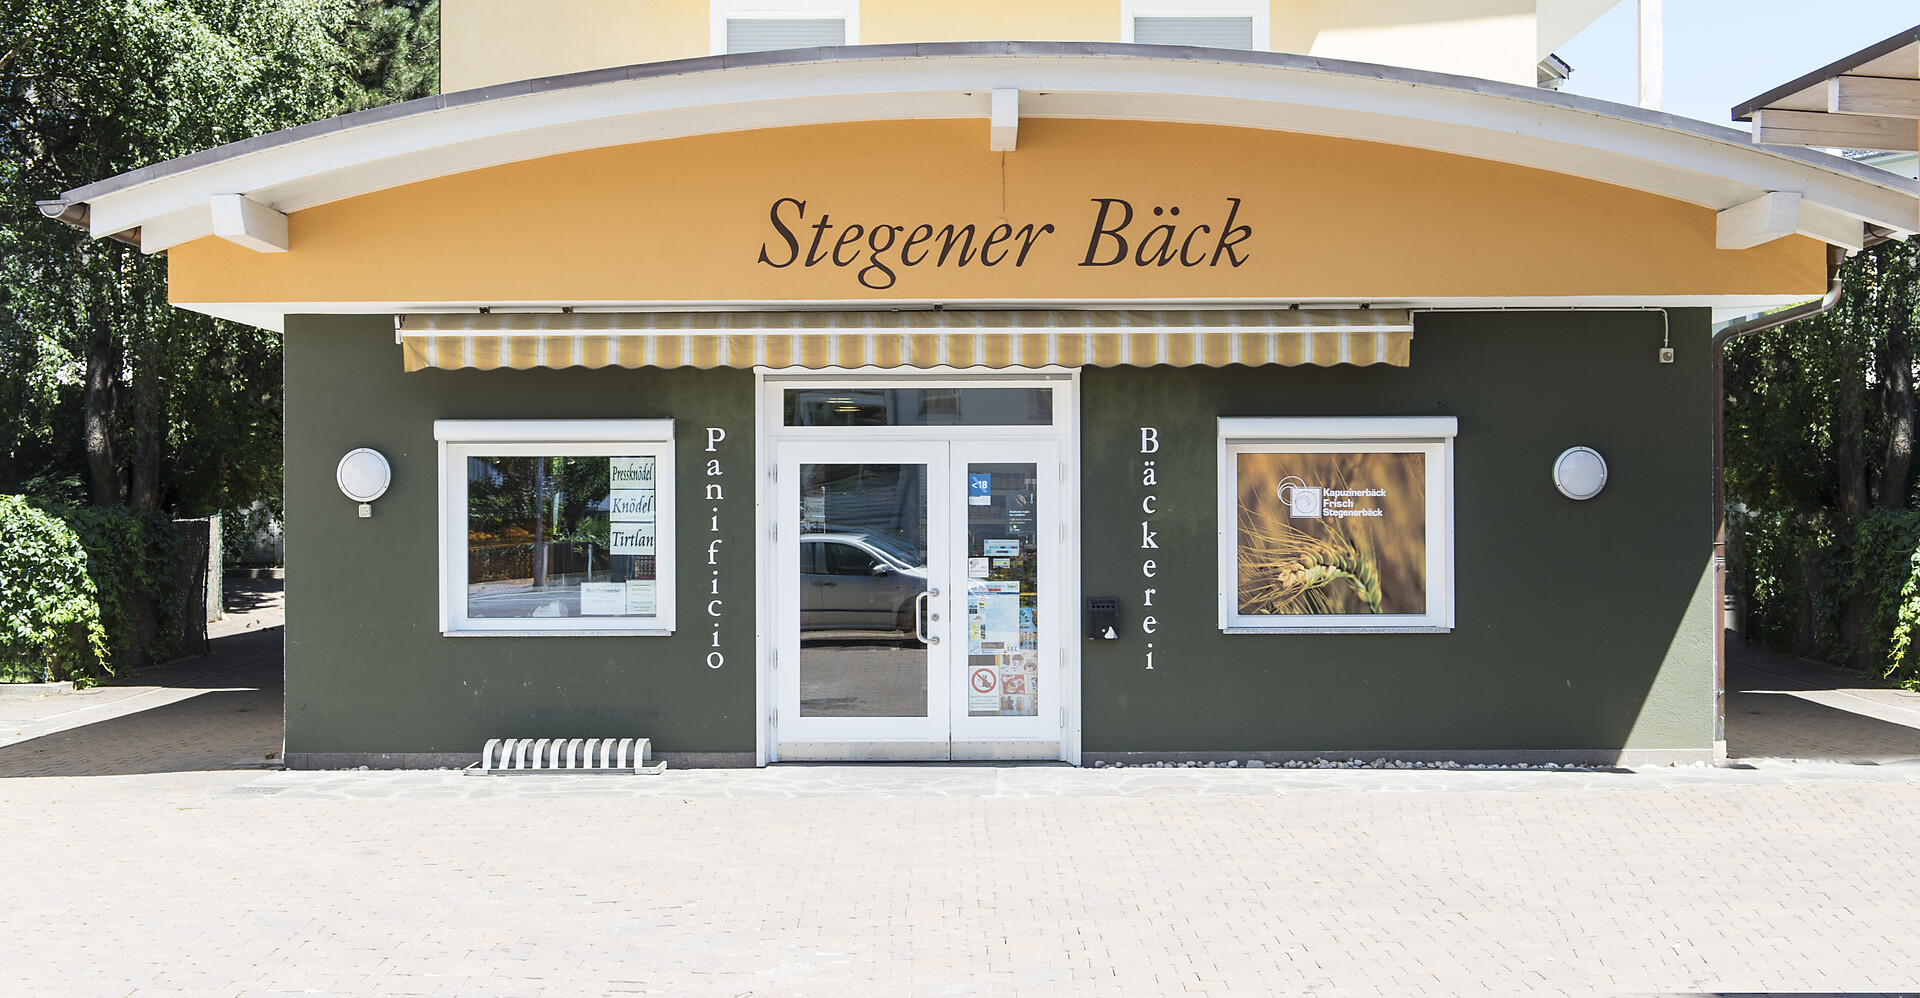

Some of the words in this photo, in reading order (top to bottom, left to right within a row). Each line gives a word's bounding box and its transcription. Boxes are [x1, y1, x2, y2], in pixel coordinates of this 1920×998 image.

[757, 197, 1055, 290] Stegener
[1077, 197, 1253, 268] Bäck
[612, 462, 653, 481] Pressknödel
[1323, 488, 1387, 499] Kapuzinerbäck
[1323, 498, 1354, 508] Frisch
[612, 495, 653, 514] Knödel
[1322, 508, 1384, 519] Stegenerbäck
[612, 528, 653, 547] Tirtlan
[705, 427, 726, 669] Panificio
[1140, 427, 1160, 670] Bäckerei
